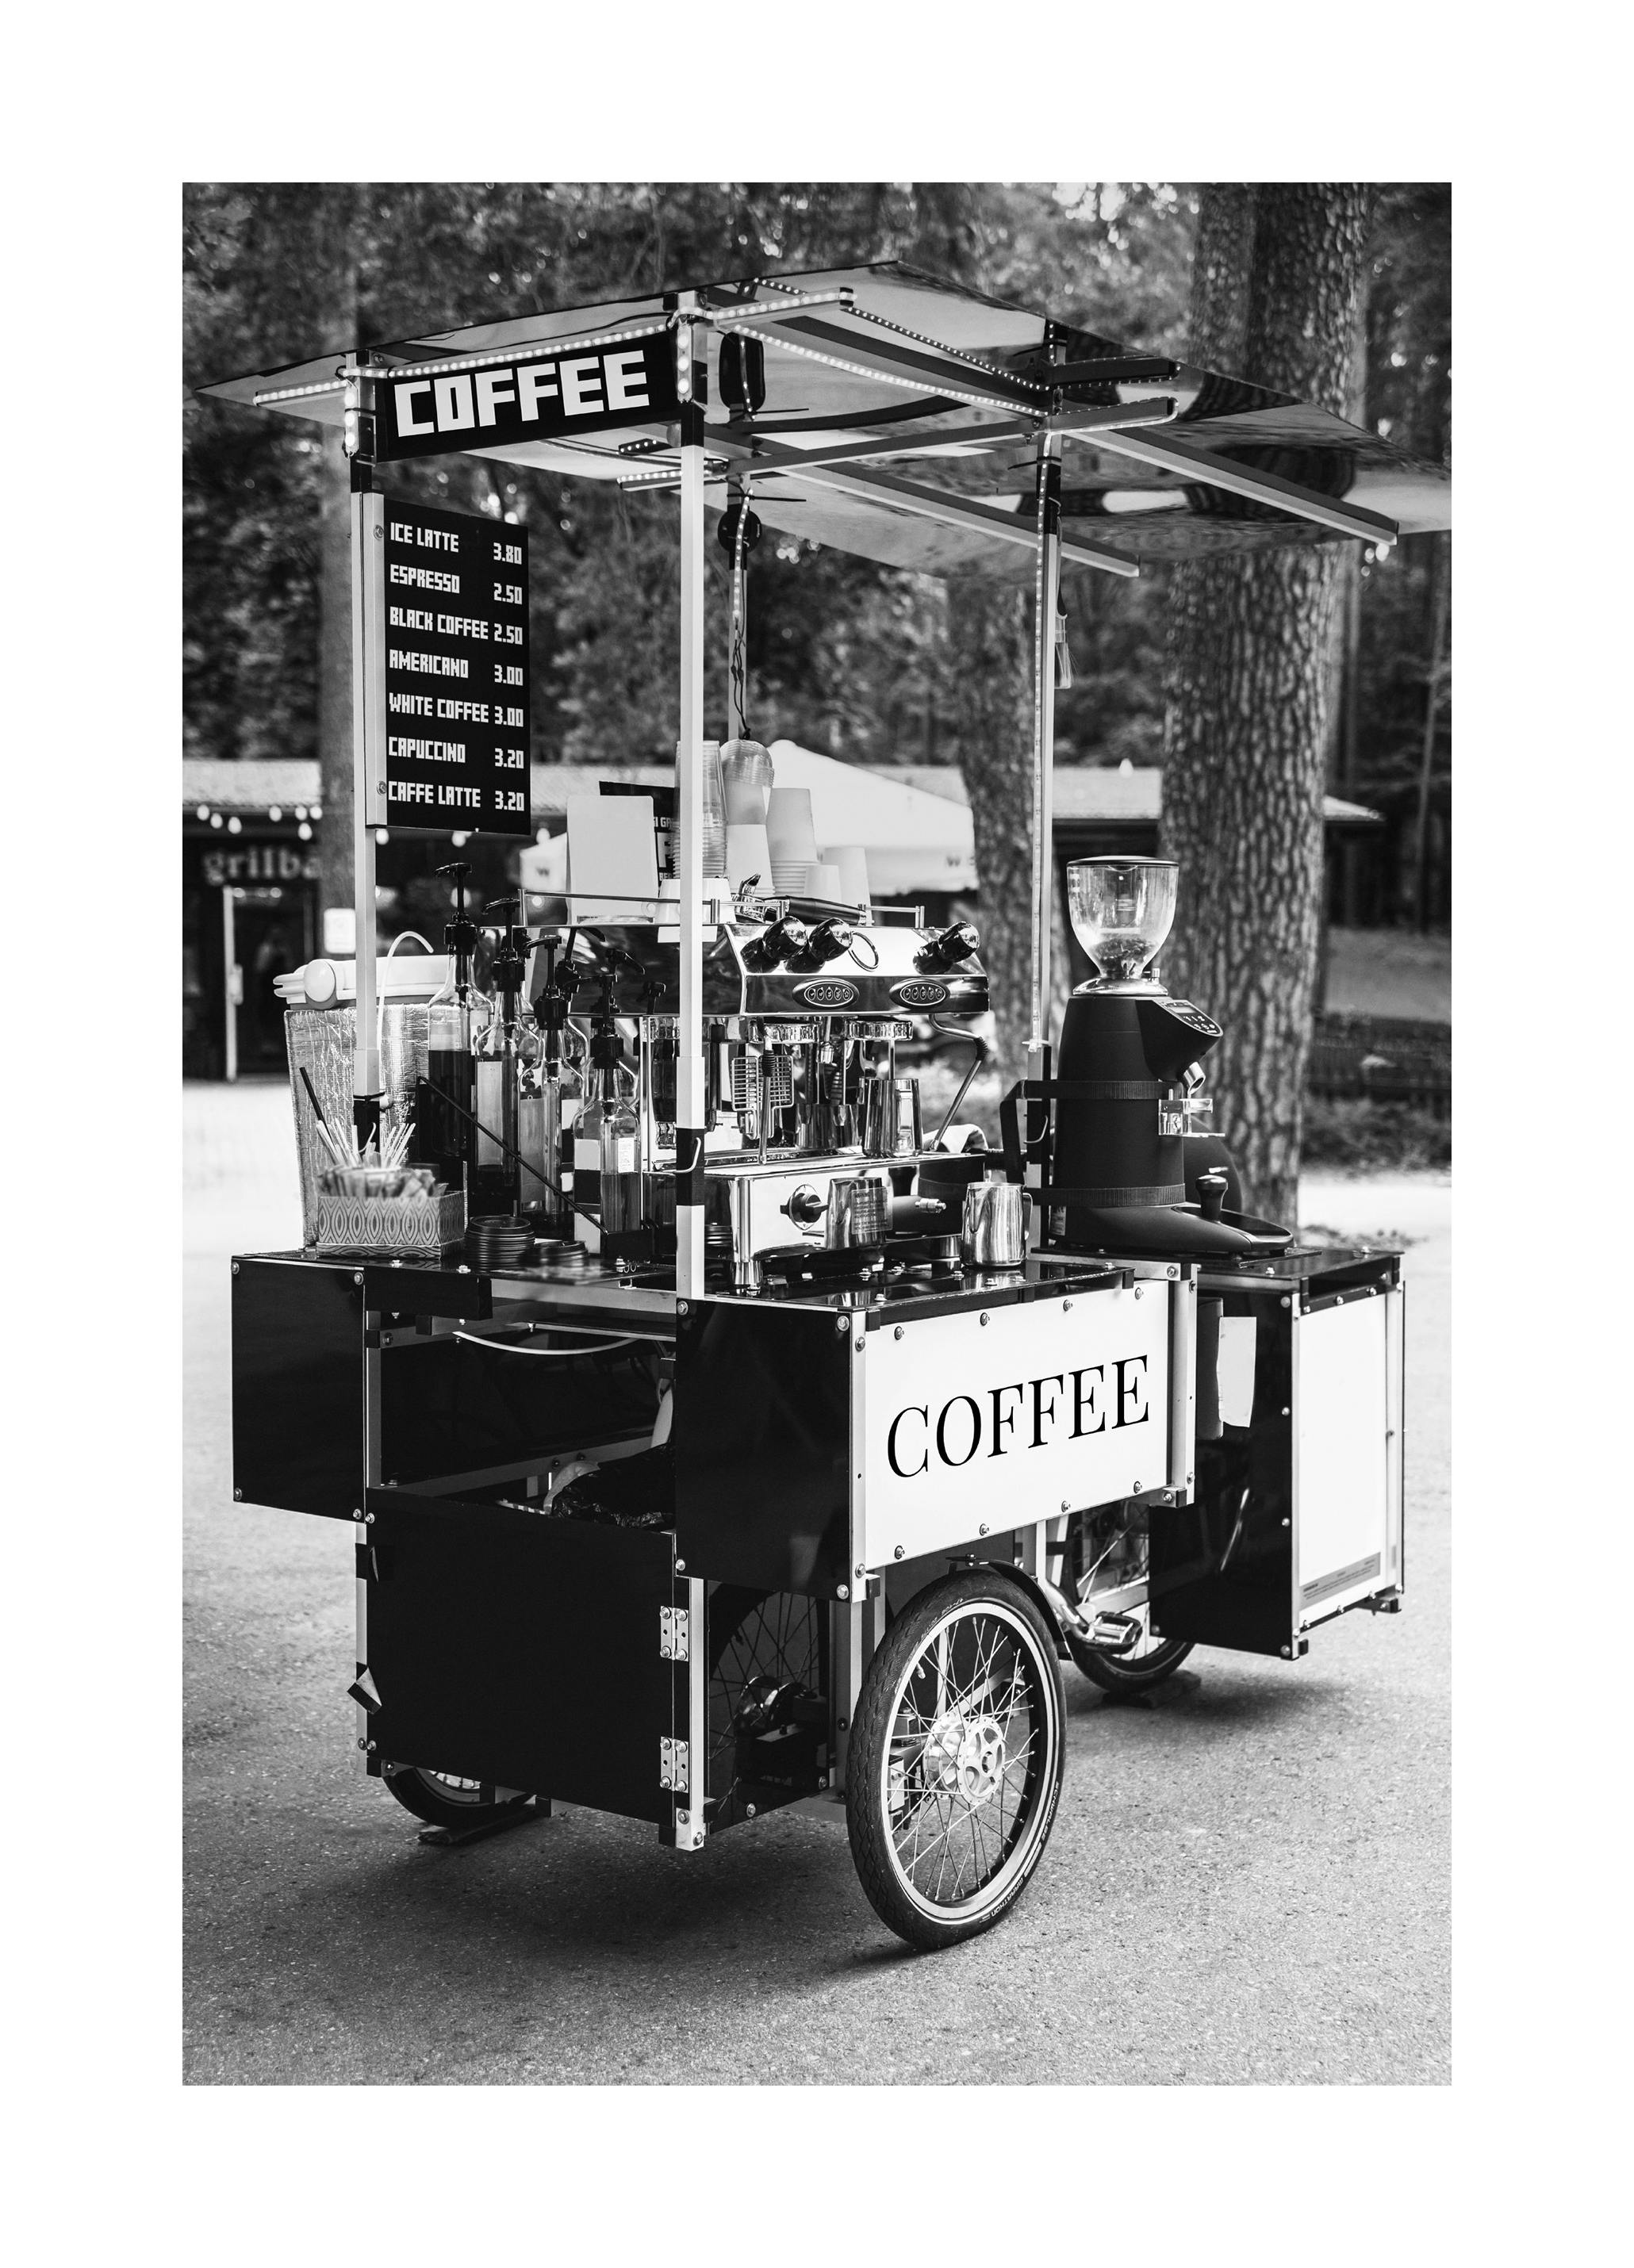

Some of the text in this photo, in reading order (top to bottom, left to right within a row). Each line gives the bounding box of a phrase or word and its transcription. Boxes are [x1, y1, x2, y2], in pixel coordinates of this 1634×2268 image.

[394, 350, 650, 437] COFFEE
[391, 523, 521, 565] ICE LATTE 3.80
[390, 565, 522, 604] ESPRESSO 2.50
[390, 607, 522, 645] BLACK COFFEE 2.50
[389, 649, 523, 685] AMERICANO 3.00
[389, 693, 523, 726] WHITE COFFEE 3.00
[389, 737, 524, 768] CAPUCCINO 3.20
[389, 781, 524, 810] CAFFE LATTE 3.20
[888, 1354, 1149, 1477] COFFEE
